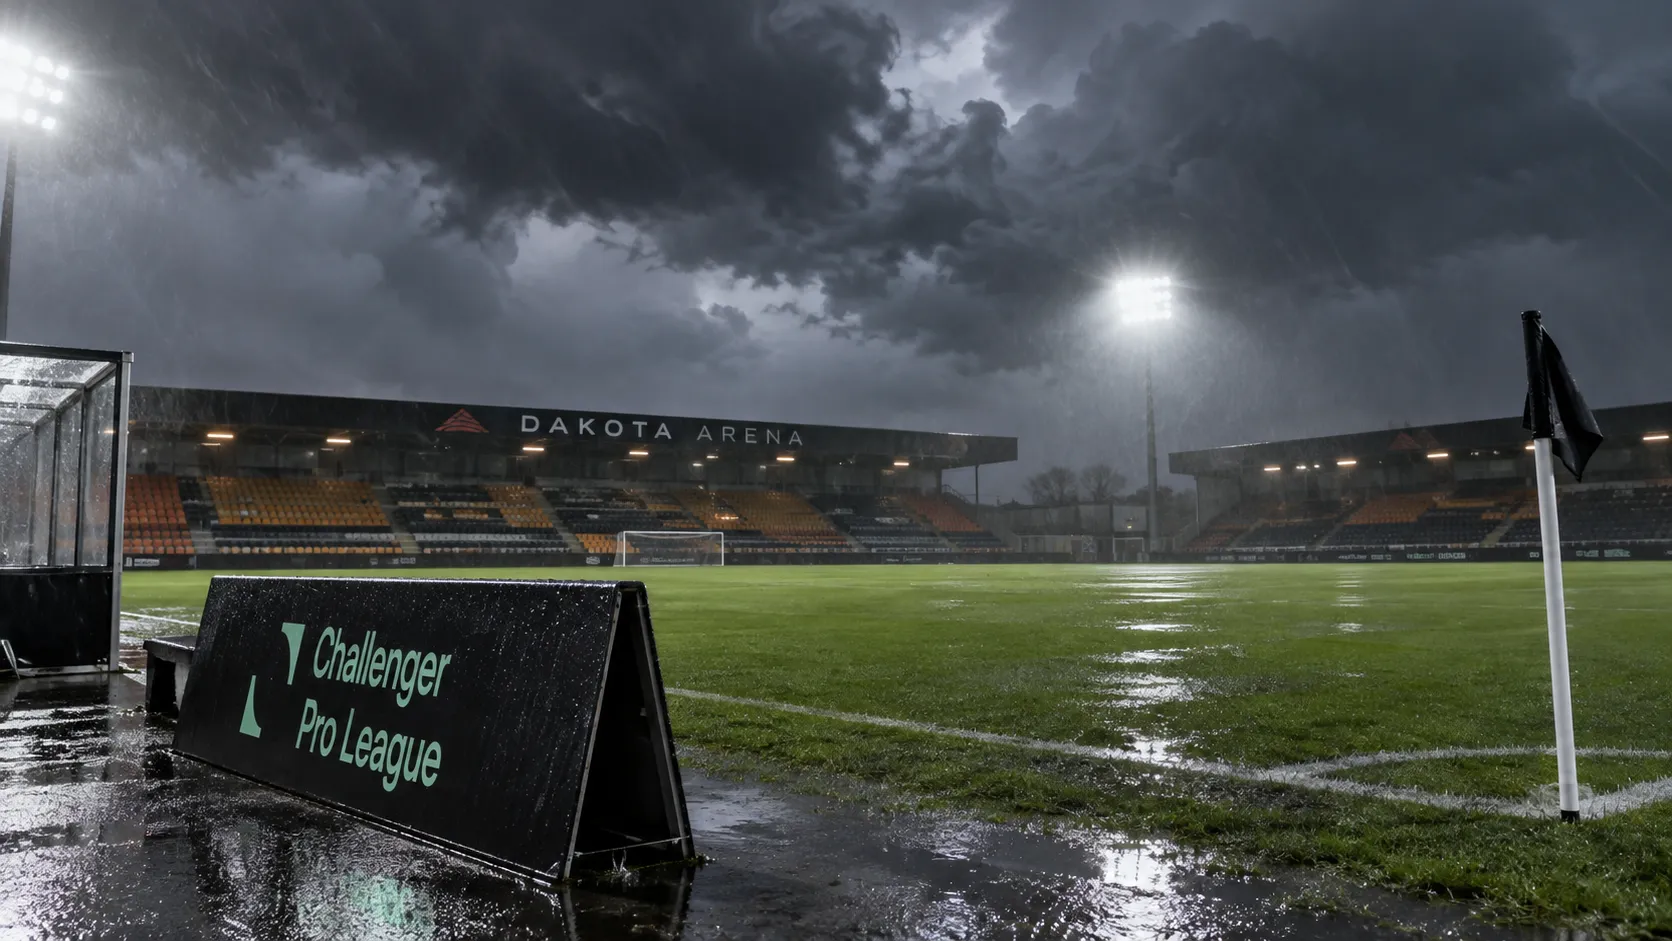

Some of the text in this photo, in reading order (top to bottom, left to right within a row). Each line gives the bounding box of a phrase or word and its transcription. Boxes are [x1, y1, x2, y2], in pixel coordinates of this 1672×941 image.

[520, 414, 804, 447] DAKOTA ARENA
[312, 626, 452, 708] Challenger
[295, 698, 442, 792] Pro League
